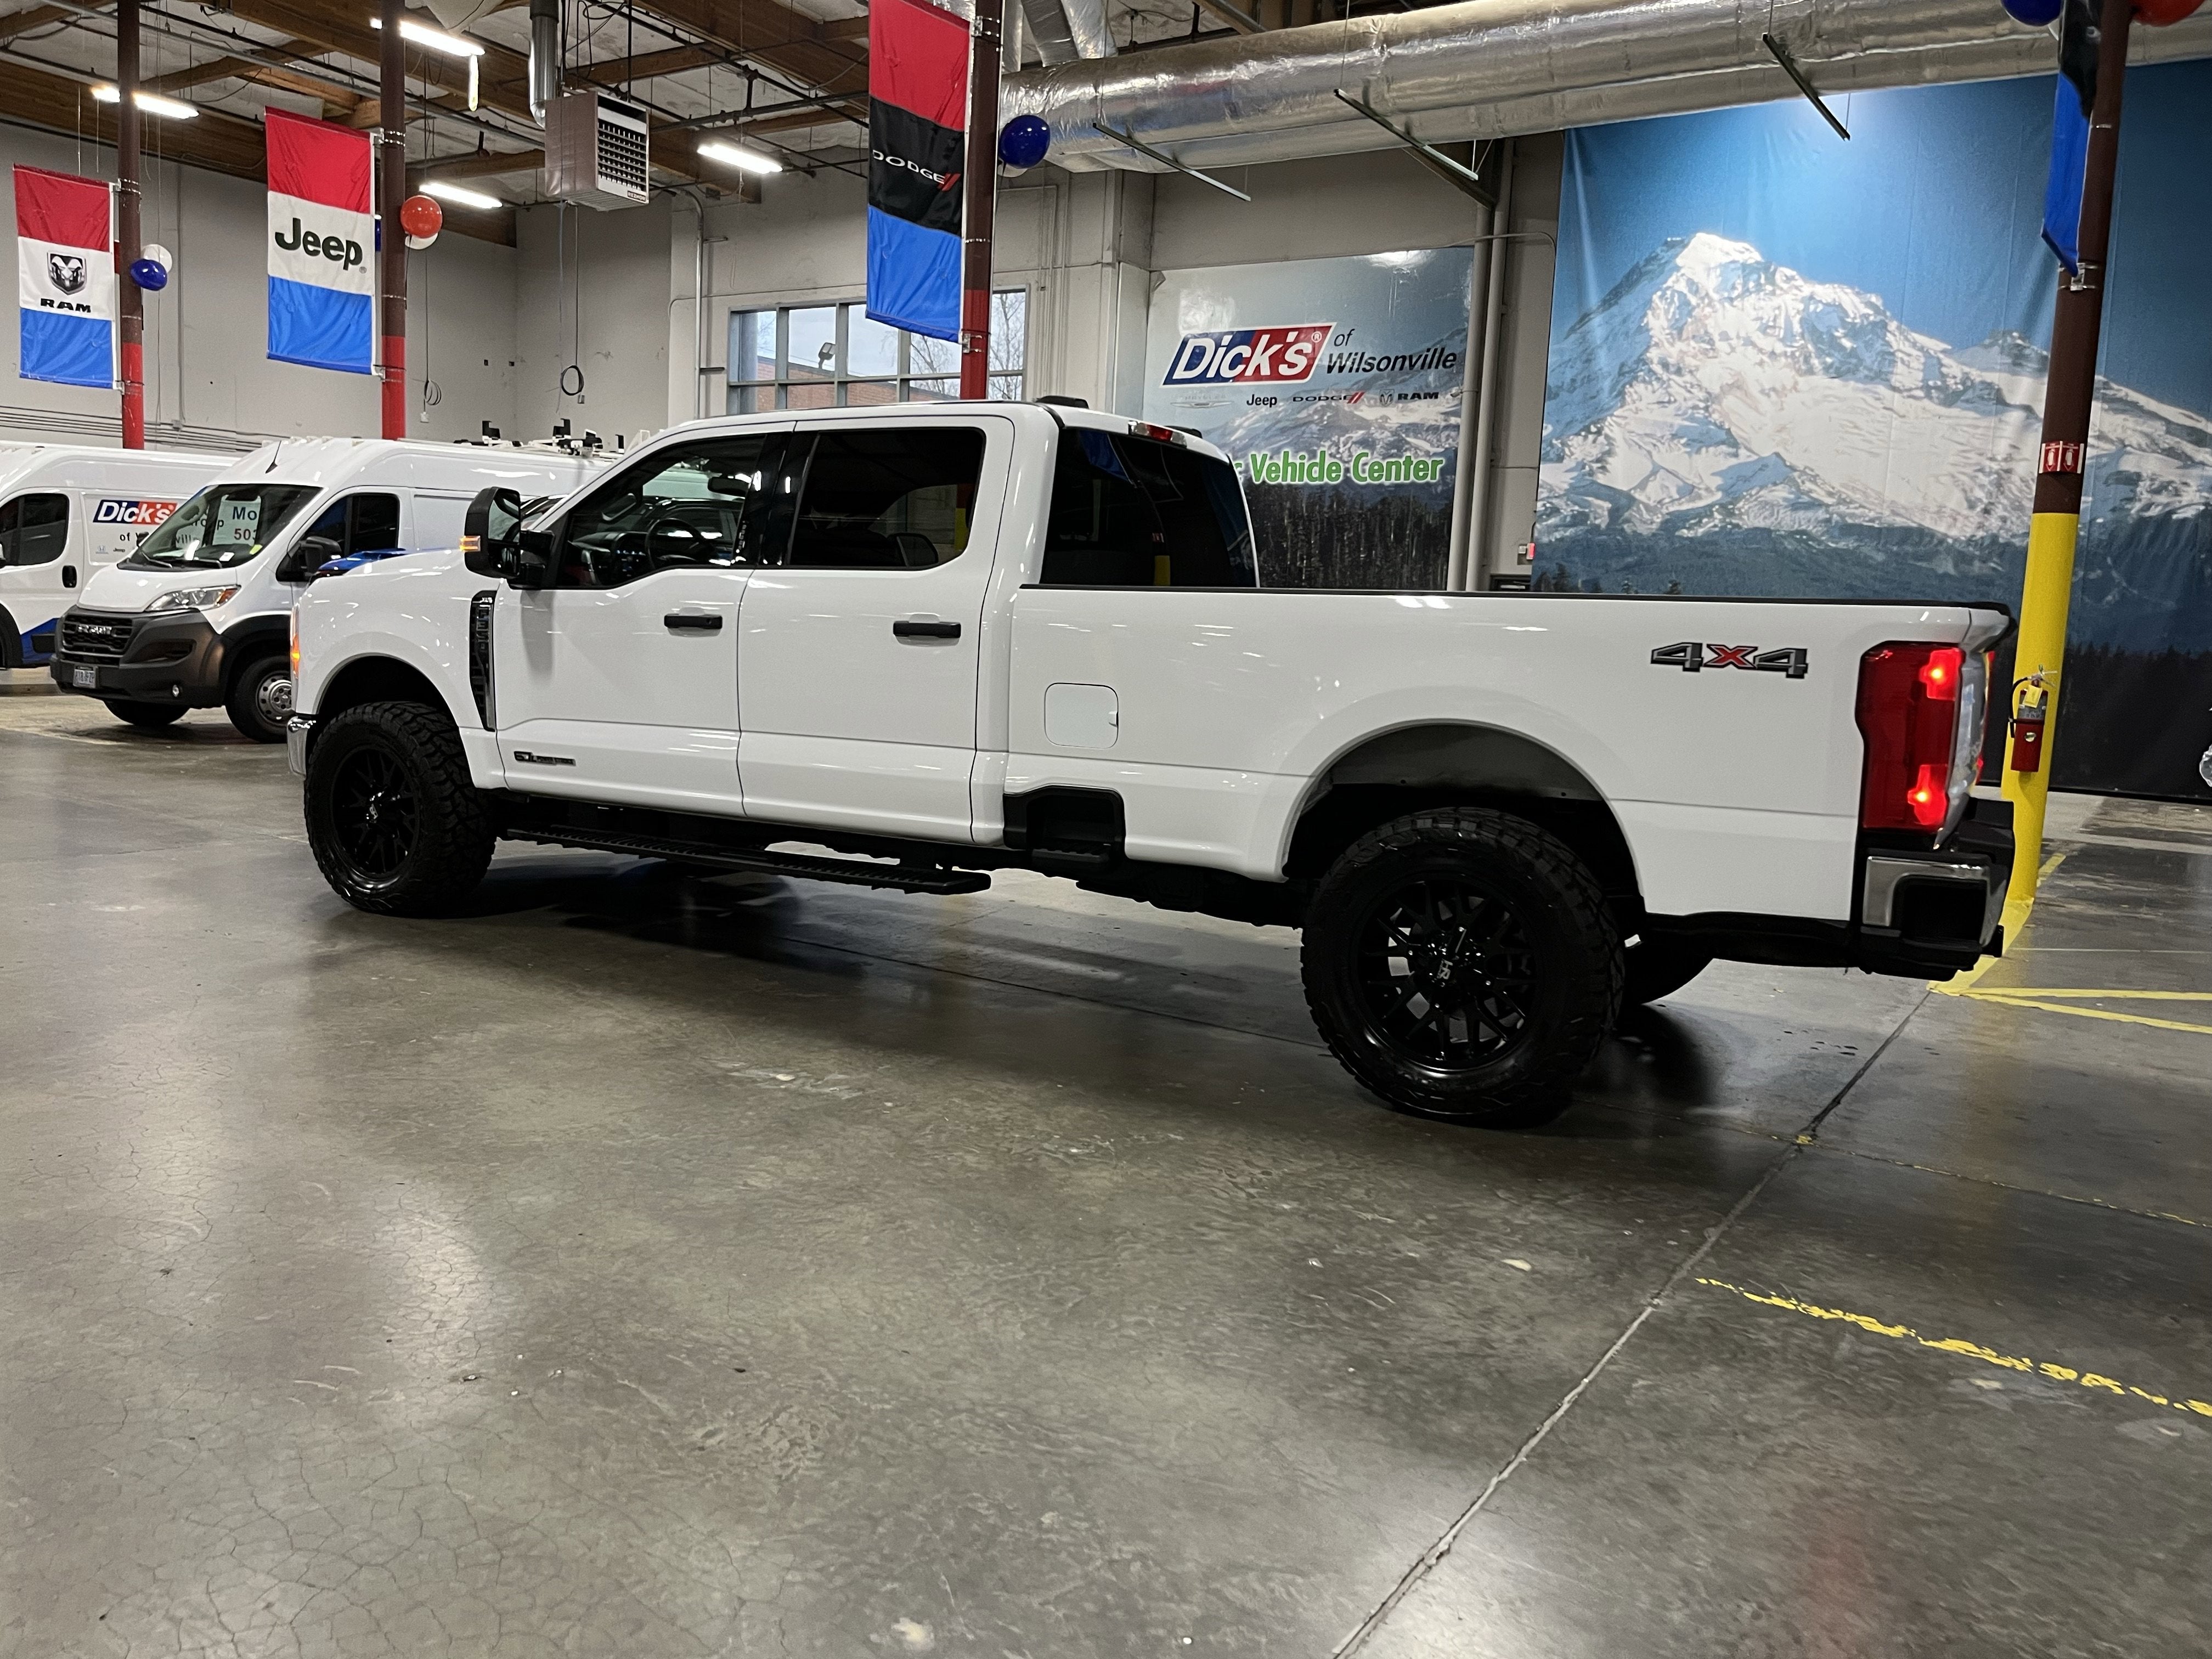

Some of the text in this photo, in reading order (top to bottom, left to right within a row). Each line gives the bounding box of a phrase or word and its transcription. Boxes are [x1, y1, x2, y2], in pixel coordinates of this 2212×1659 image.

[872, 149, 945, 184] DODGE
[275, 217, 363, 270] Jeep
[41, 298, 91, 313] RAM
[1172, 329, 1356, 380] Dick's of
[1327, 347, 1457, 374] Wilsonville
[1246, 394, 1277, 408] Jeep
[1398, 392, 1438, 400] RAM
[1250, 450, 1341, 483] Vehicle
[1352, 452, 1443, 482] Center
[98, 501, 171, 524] Dick's
[120, 532, 130, 541] of
